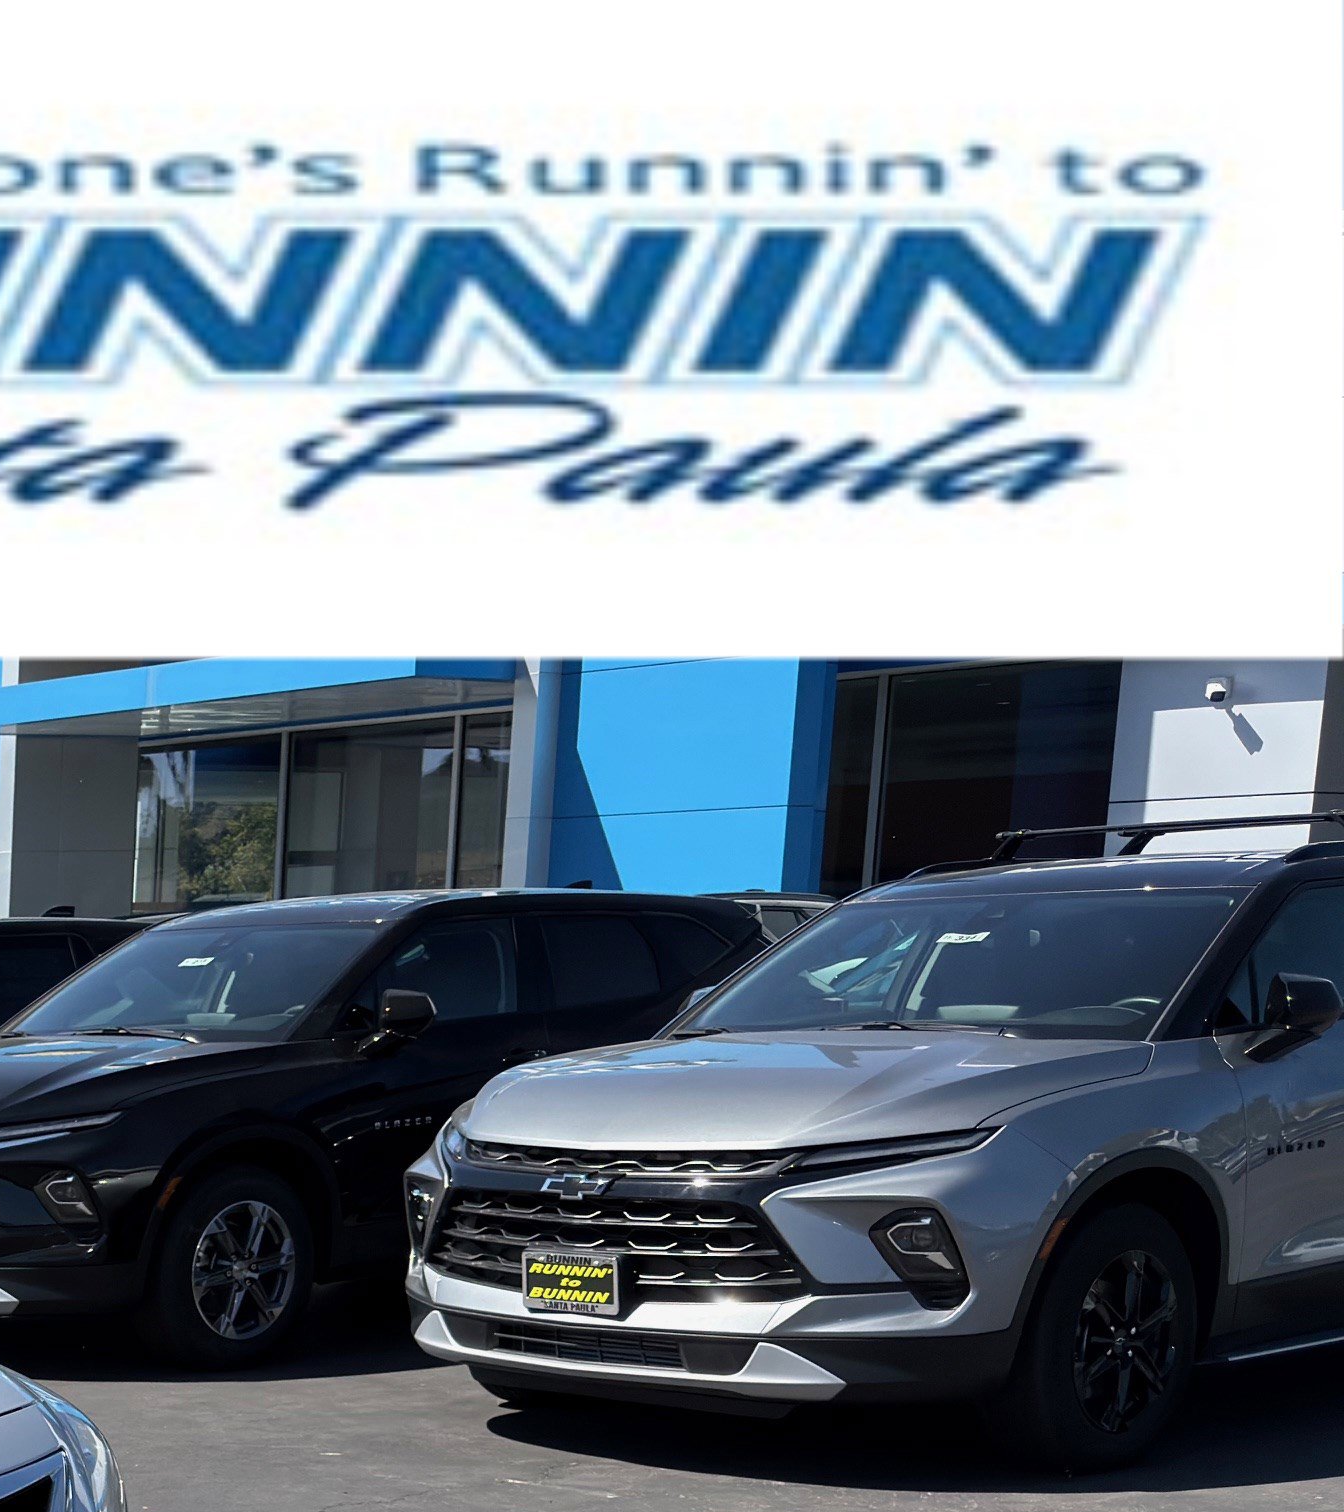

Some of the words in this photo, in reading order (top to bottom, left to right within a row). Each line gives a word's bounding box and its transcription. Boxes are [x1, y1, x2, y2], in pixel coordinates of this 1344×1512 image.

[545, 1254, 593, 1266] BUNNIN
[528, 1262, 614, 1279] RUNNIN'
[559, 1277, 582, 1288] to
[528, 1287, 611, 1304] BUNNIN
